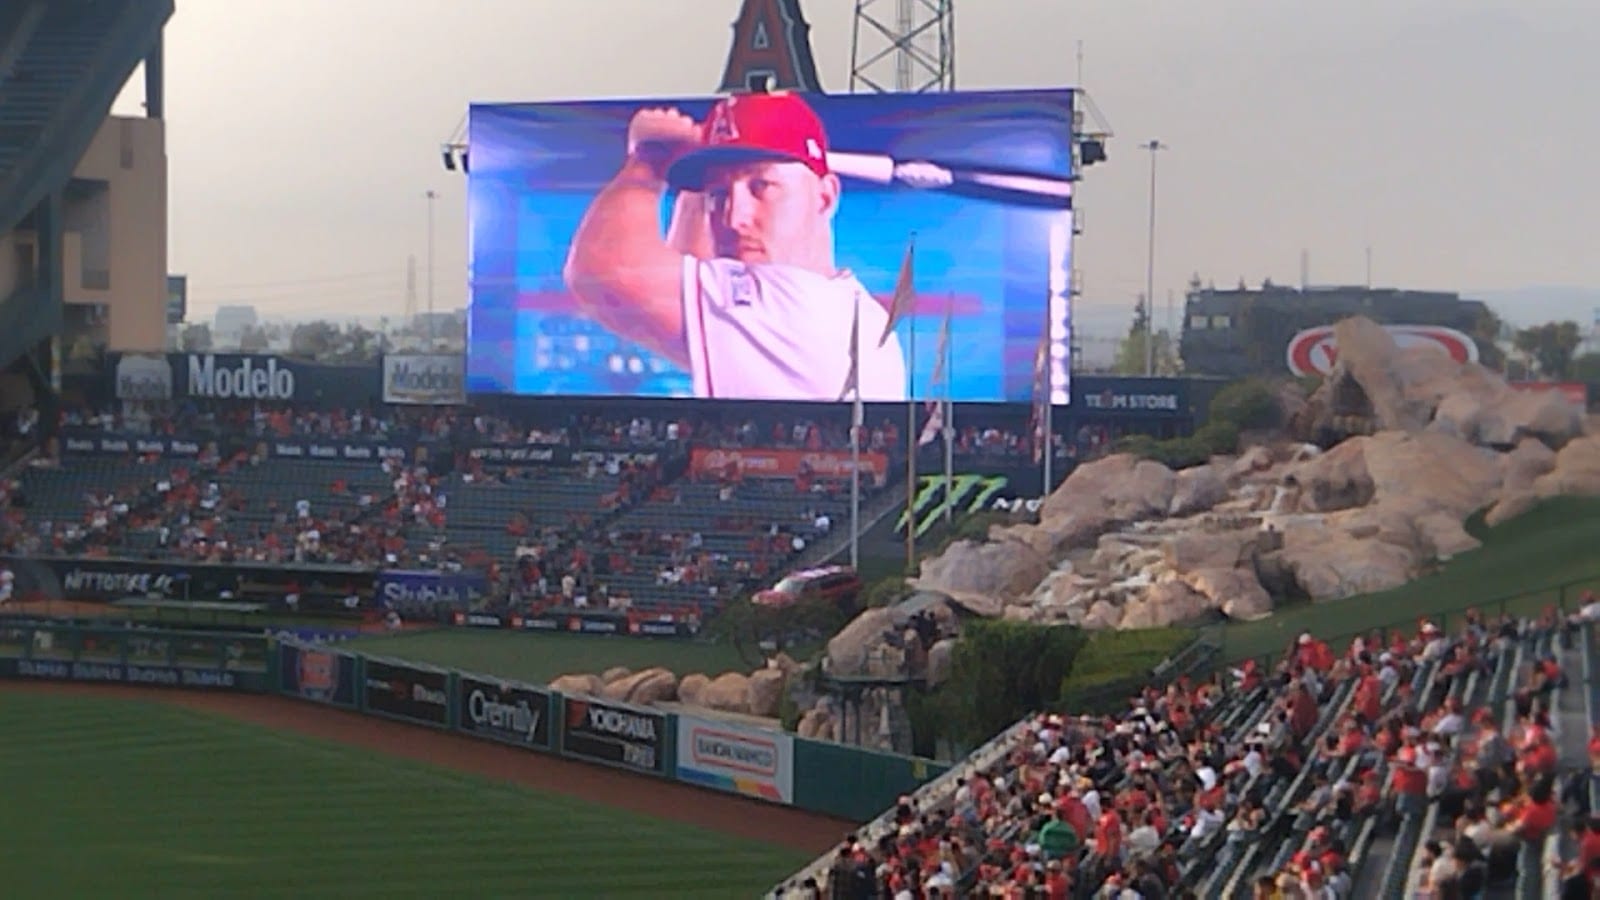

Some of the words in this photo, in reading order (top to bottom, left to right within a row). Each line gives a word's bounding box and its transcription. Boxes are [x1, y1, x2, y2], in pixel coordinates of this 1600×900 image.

[188, 354, 295, 399] Modelo
[1084, 389, 1127, 409] TEAM
[1129, 394, 1177, 410] STORE
